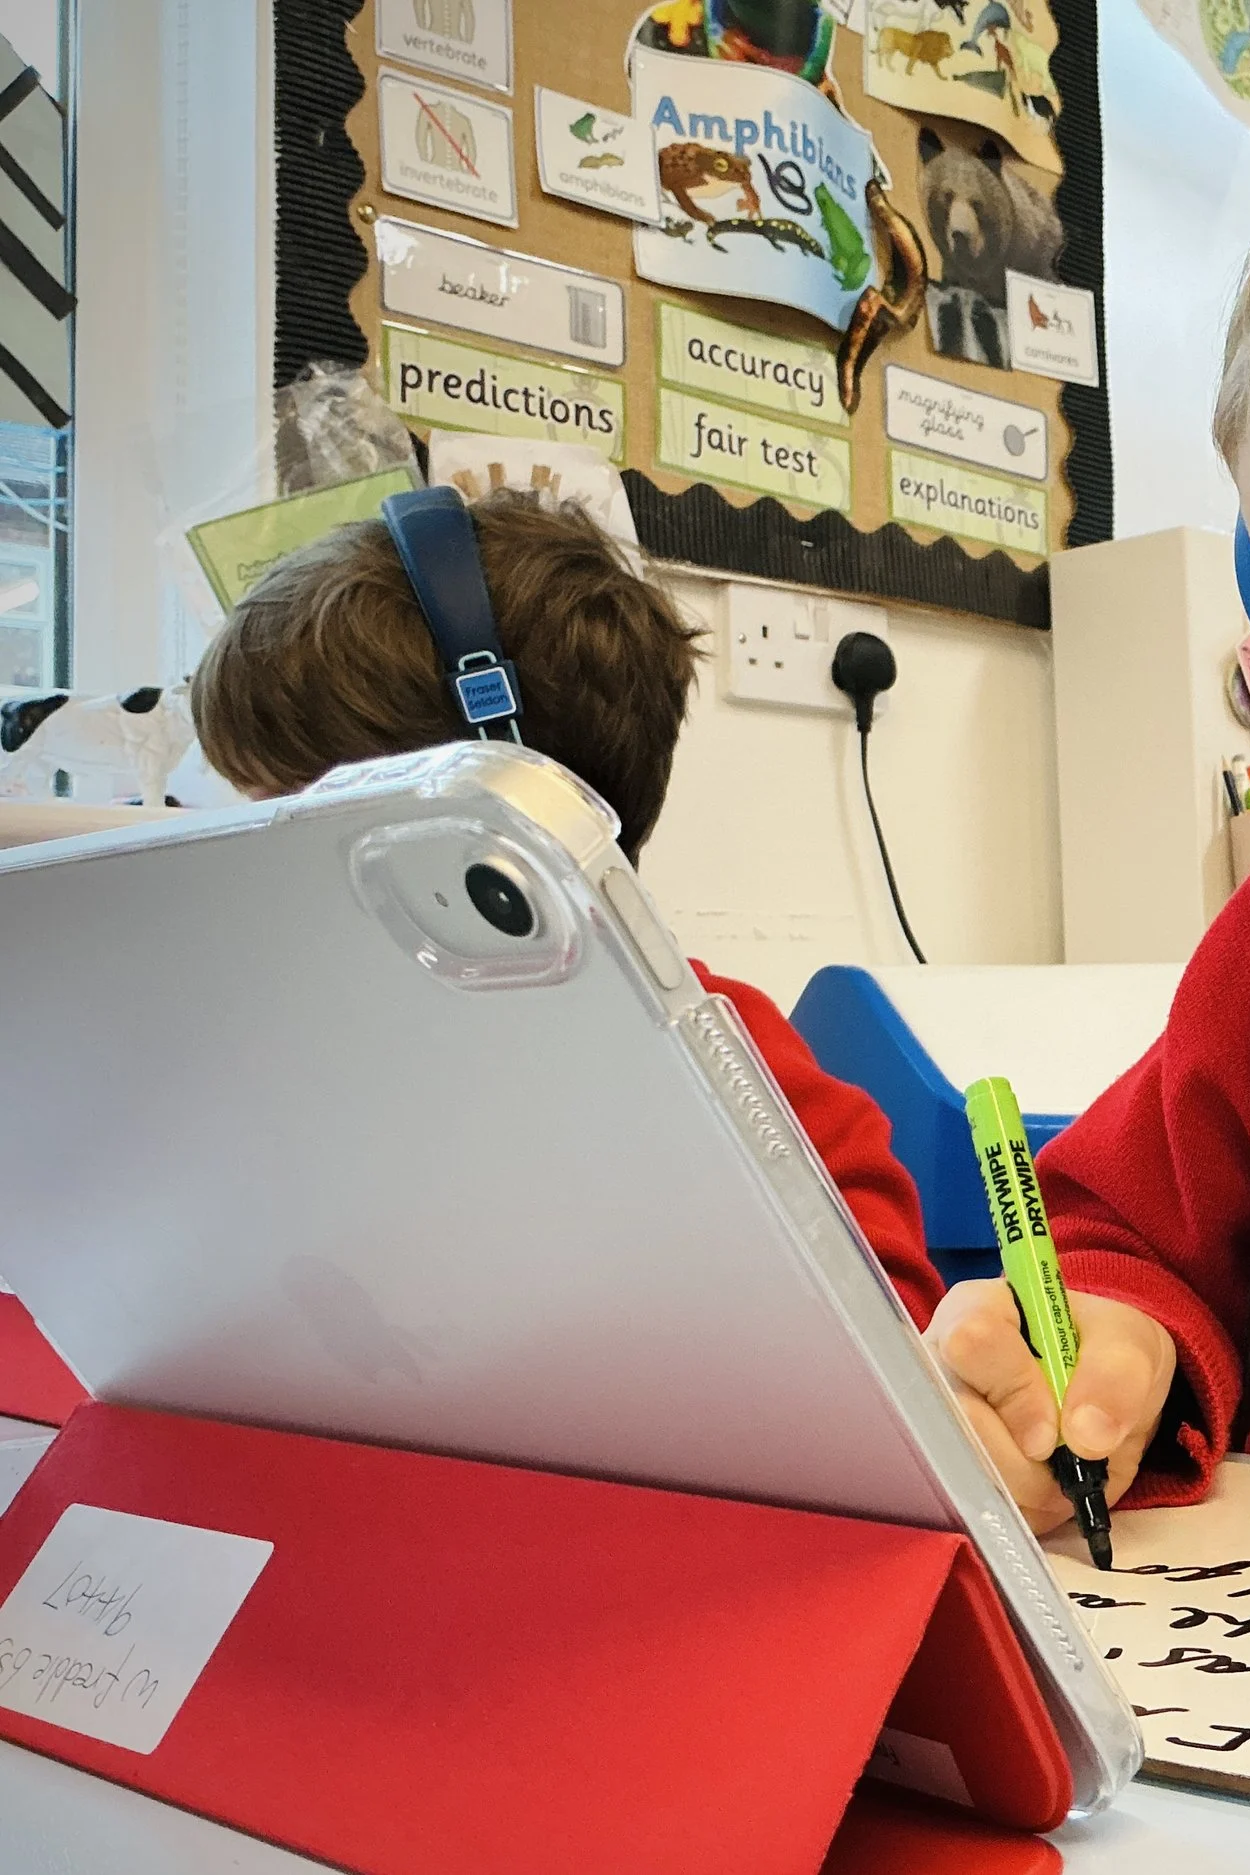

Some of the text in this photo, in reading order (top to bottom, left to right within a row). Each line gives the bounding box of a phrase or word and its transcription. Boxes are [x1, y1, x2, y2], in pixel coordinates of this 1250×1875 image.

[402, 33, 488, 70] vertebrate
[652, 96, 858, 201] Amphibians
[399, 164, 499, 204] invertebrate
[437, 272, 512, 307] beaker
[688, 336, 825, 407] accuracy
[400, 362, 614, 434] predictions
[898, 389, 985, 432] magnifying
[690, 411, 819, 478] fair test
[899, 477, 1039, 531] explanations
[985, 1142, 1024, 1244] DRYWIPE
[1010, 1139, 1047, 1237] DRYWIPE
[1040, 1260, 1053, 1284] time
[1044, 1287, 1063, 1324] cap-off
[1057, 1327, 1076, 1369] 72-hour
